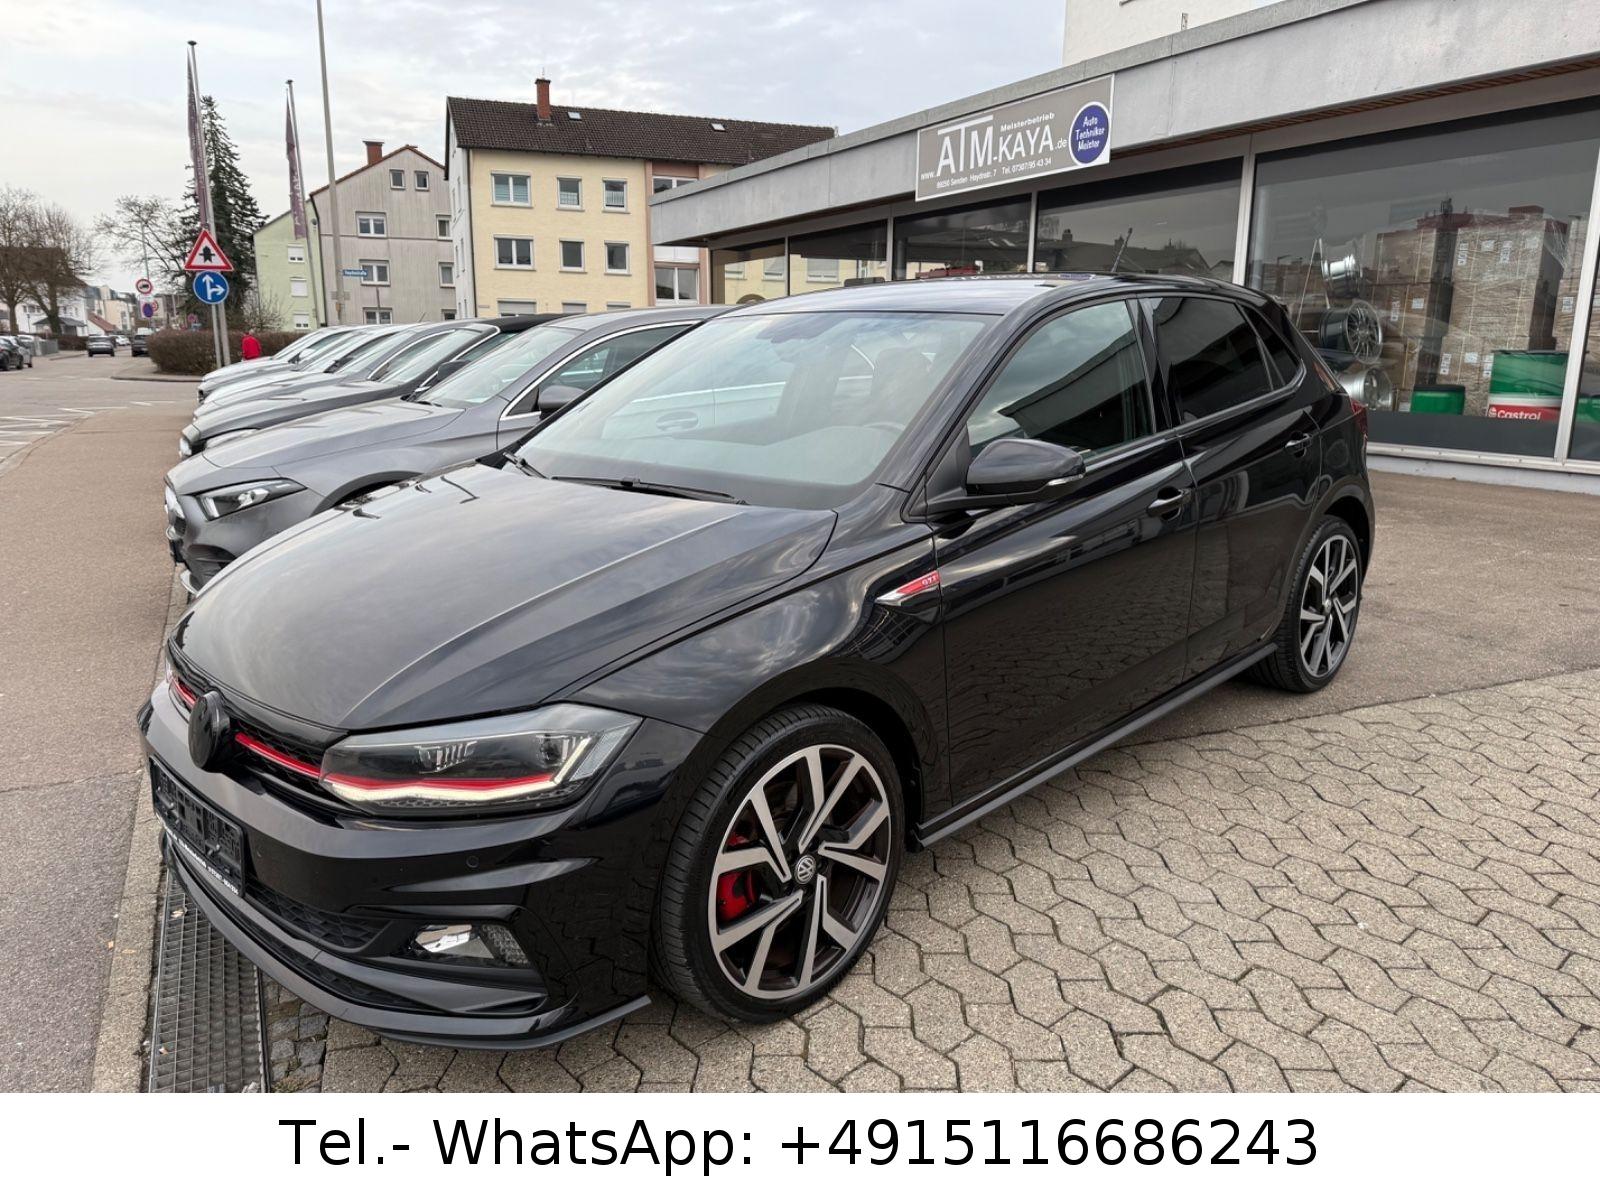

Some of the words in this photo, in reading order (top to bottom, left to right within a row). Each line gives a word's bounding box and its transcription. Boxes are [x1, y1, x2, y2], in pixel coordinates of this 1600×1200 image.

[1000, 112, 1055, 132] Meisterbetrieb
[1083, 116, 1098, 127] Auto
[1075, 127, 1105, 140] Techniker
[1078, 140, 1100, 151] Meister
[1497, 410, 1541, 420] Castrol
